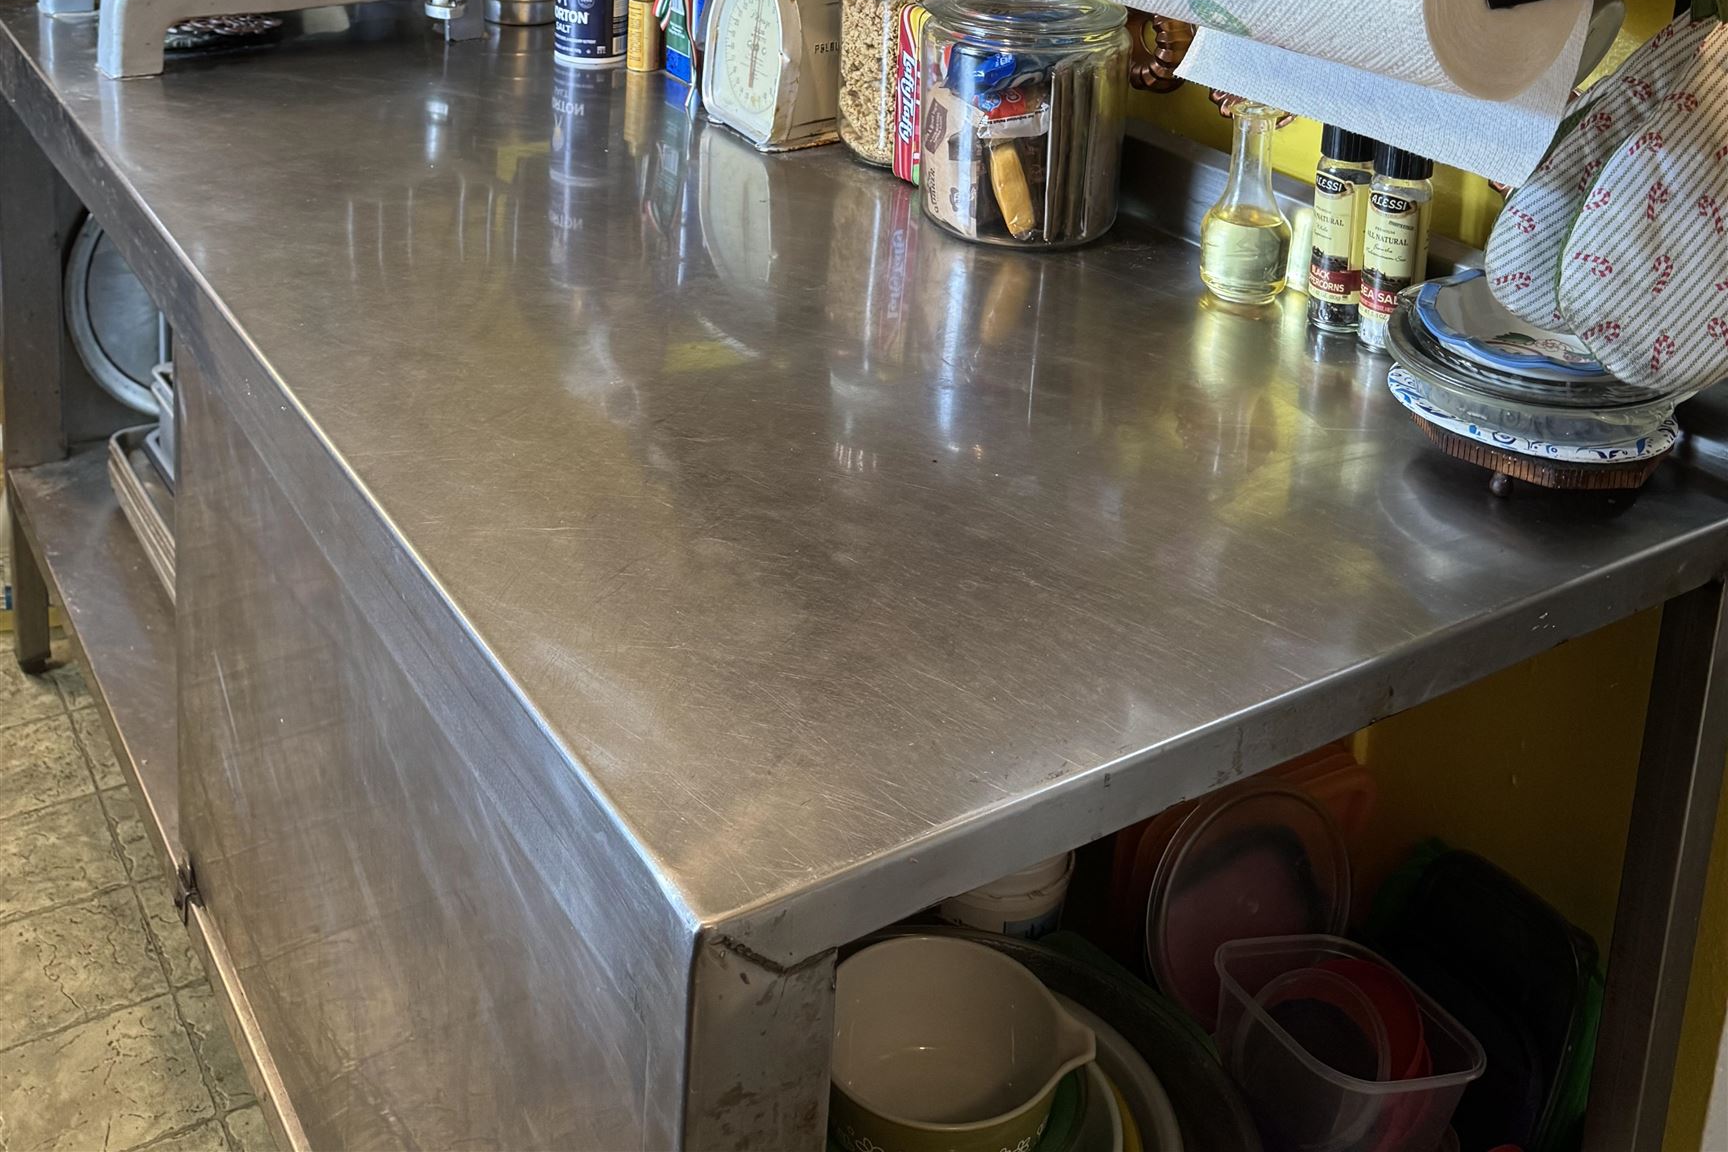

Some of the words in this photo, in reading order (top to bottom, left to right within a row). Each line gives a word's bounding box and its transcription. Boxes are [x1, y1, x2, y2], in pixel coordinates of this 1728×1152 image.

[554, 5, 589, 25] ORTON
[555, 21, 571, 34] SALT
[1315, 177, 1343, 193] LESSI
[1370, 195, 1408, 211] ALESSI
[1375, 232, 1409, 246] NATURAL
[1309, 274, 1345, 293] PERCORNS
[1360, 283, 1374, 299] SEA
[1377, 290, 1402, 306] SAL
